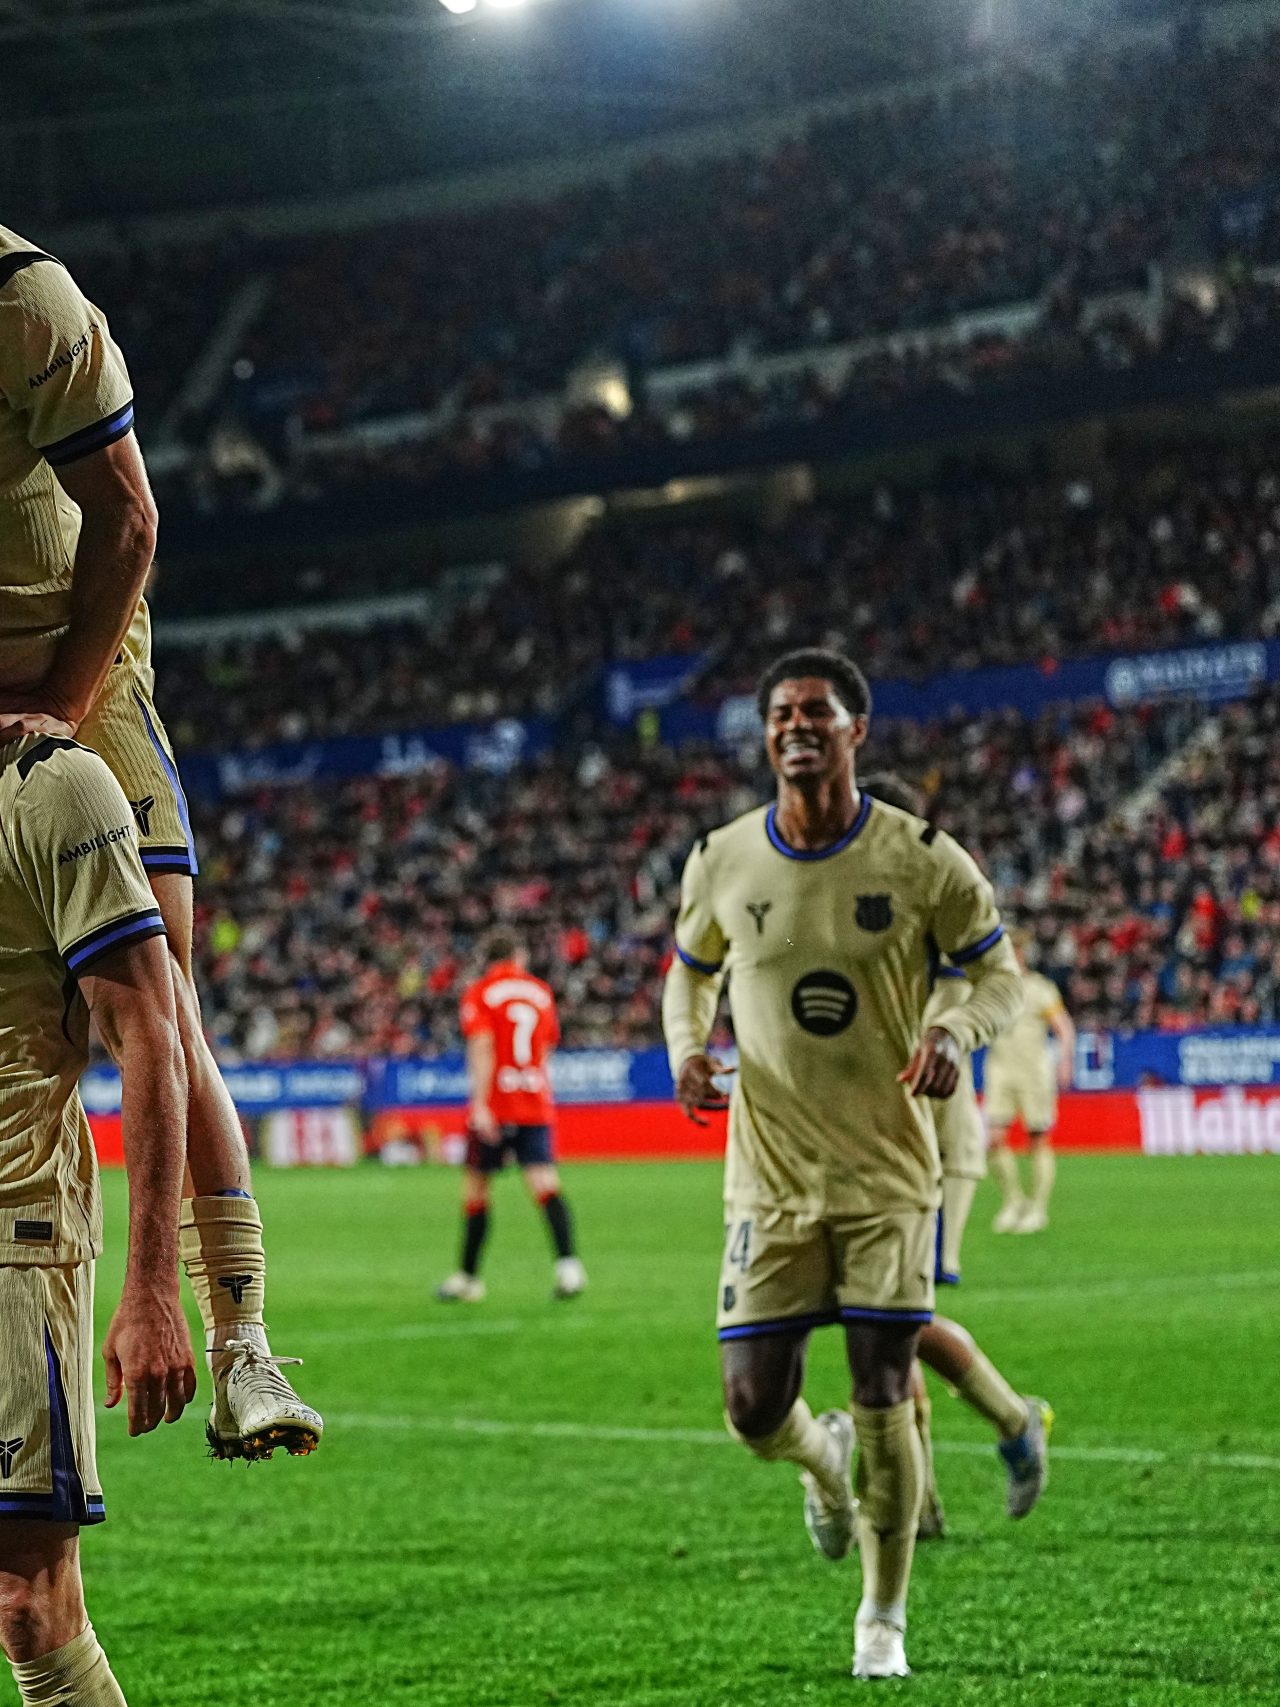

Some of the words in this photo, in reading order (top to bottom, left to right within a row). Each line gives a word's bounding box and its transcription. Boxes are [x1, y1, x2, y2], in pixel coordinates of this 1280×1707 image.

[28, 333, 90, 390] AMBILIGH
[59, 825, 131, 867] AMBILIGHT
[507, 1003, 539, 1067] 7
